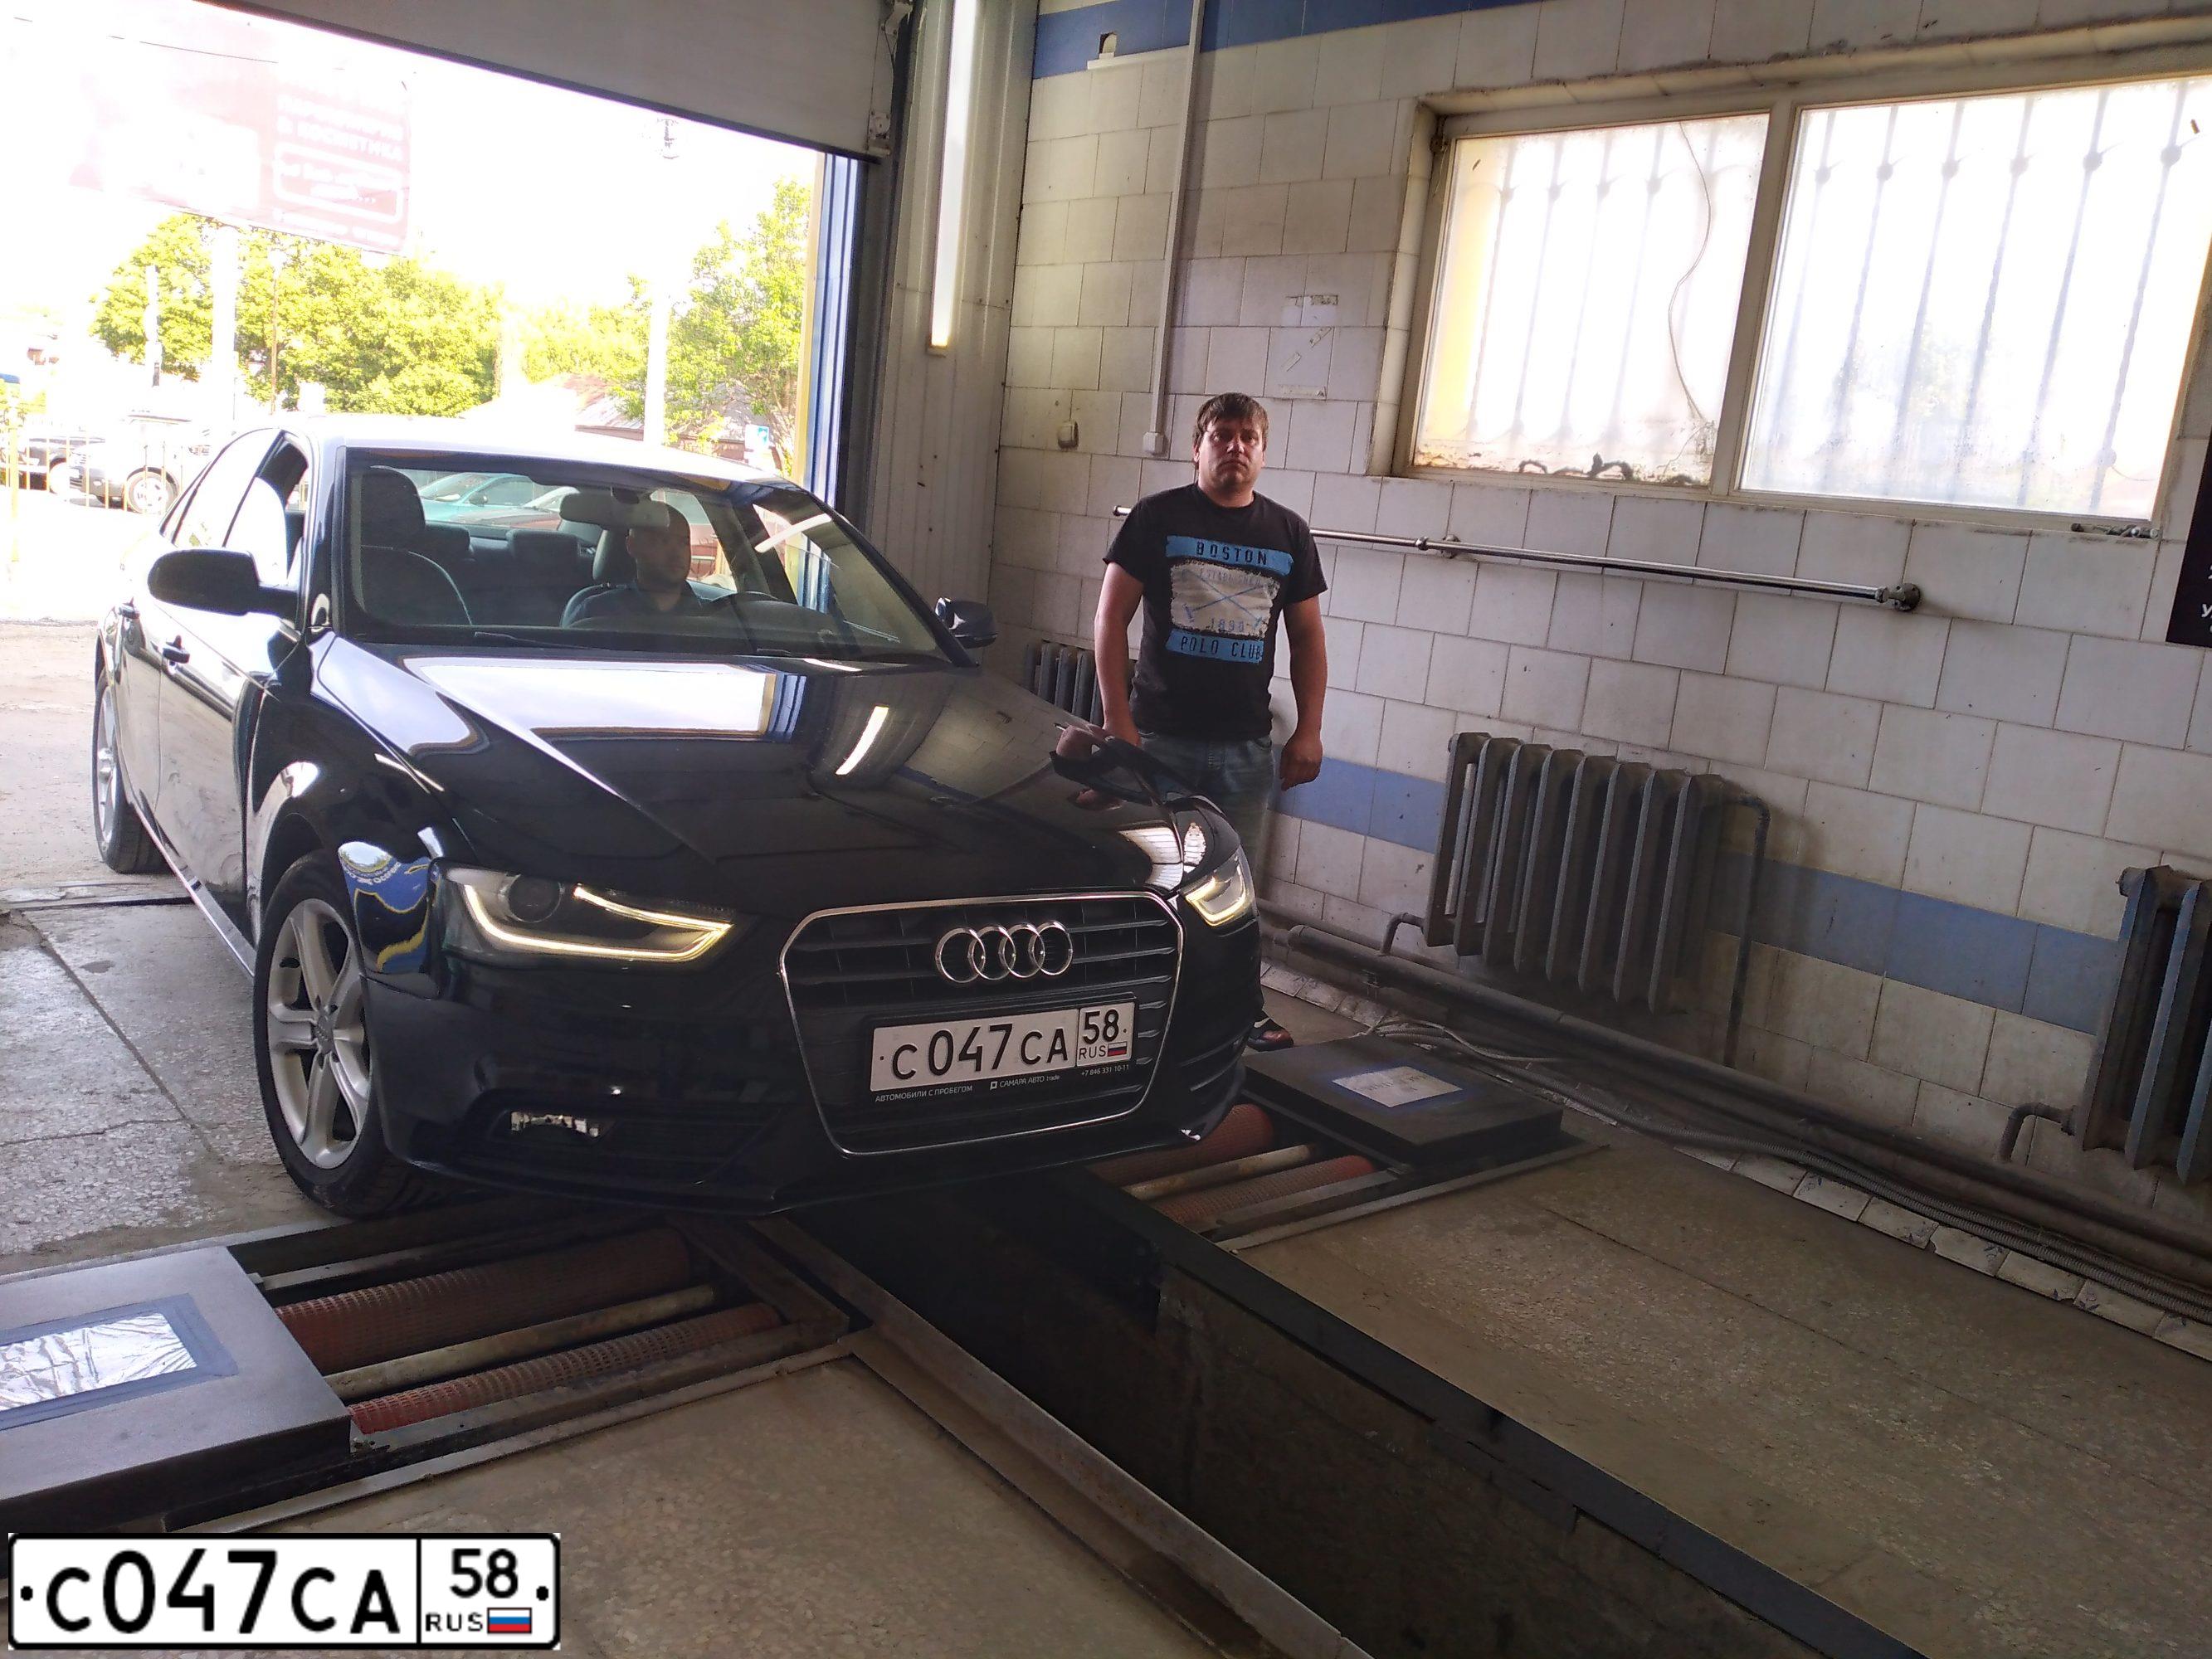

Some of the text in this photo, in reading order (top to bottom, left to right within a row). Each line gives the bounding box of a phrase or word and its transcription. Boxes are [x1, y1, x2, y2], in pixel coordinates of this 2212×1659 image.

[1196, 541, 1267, 566] BOSTON
[1181, 635, 1260, 660] POLO CLUB
[1083, 1009, 1119, 1044] 58
[1079, 1045, 1107, 1060] RUS
[875, 1090, 927, 1102] АВТОМОБИЛИ
[934, 1085, 973, 1096] ПРОБЕГОМ
[999, 1078, 1026, 1088] САМАРА
